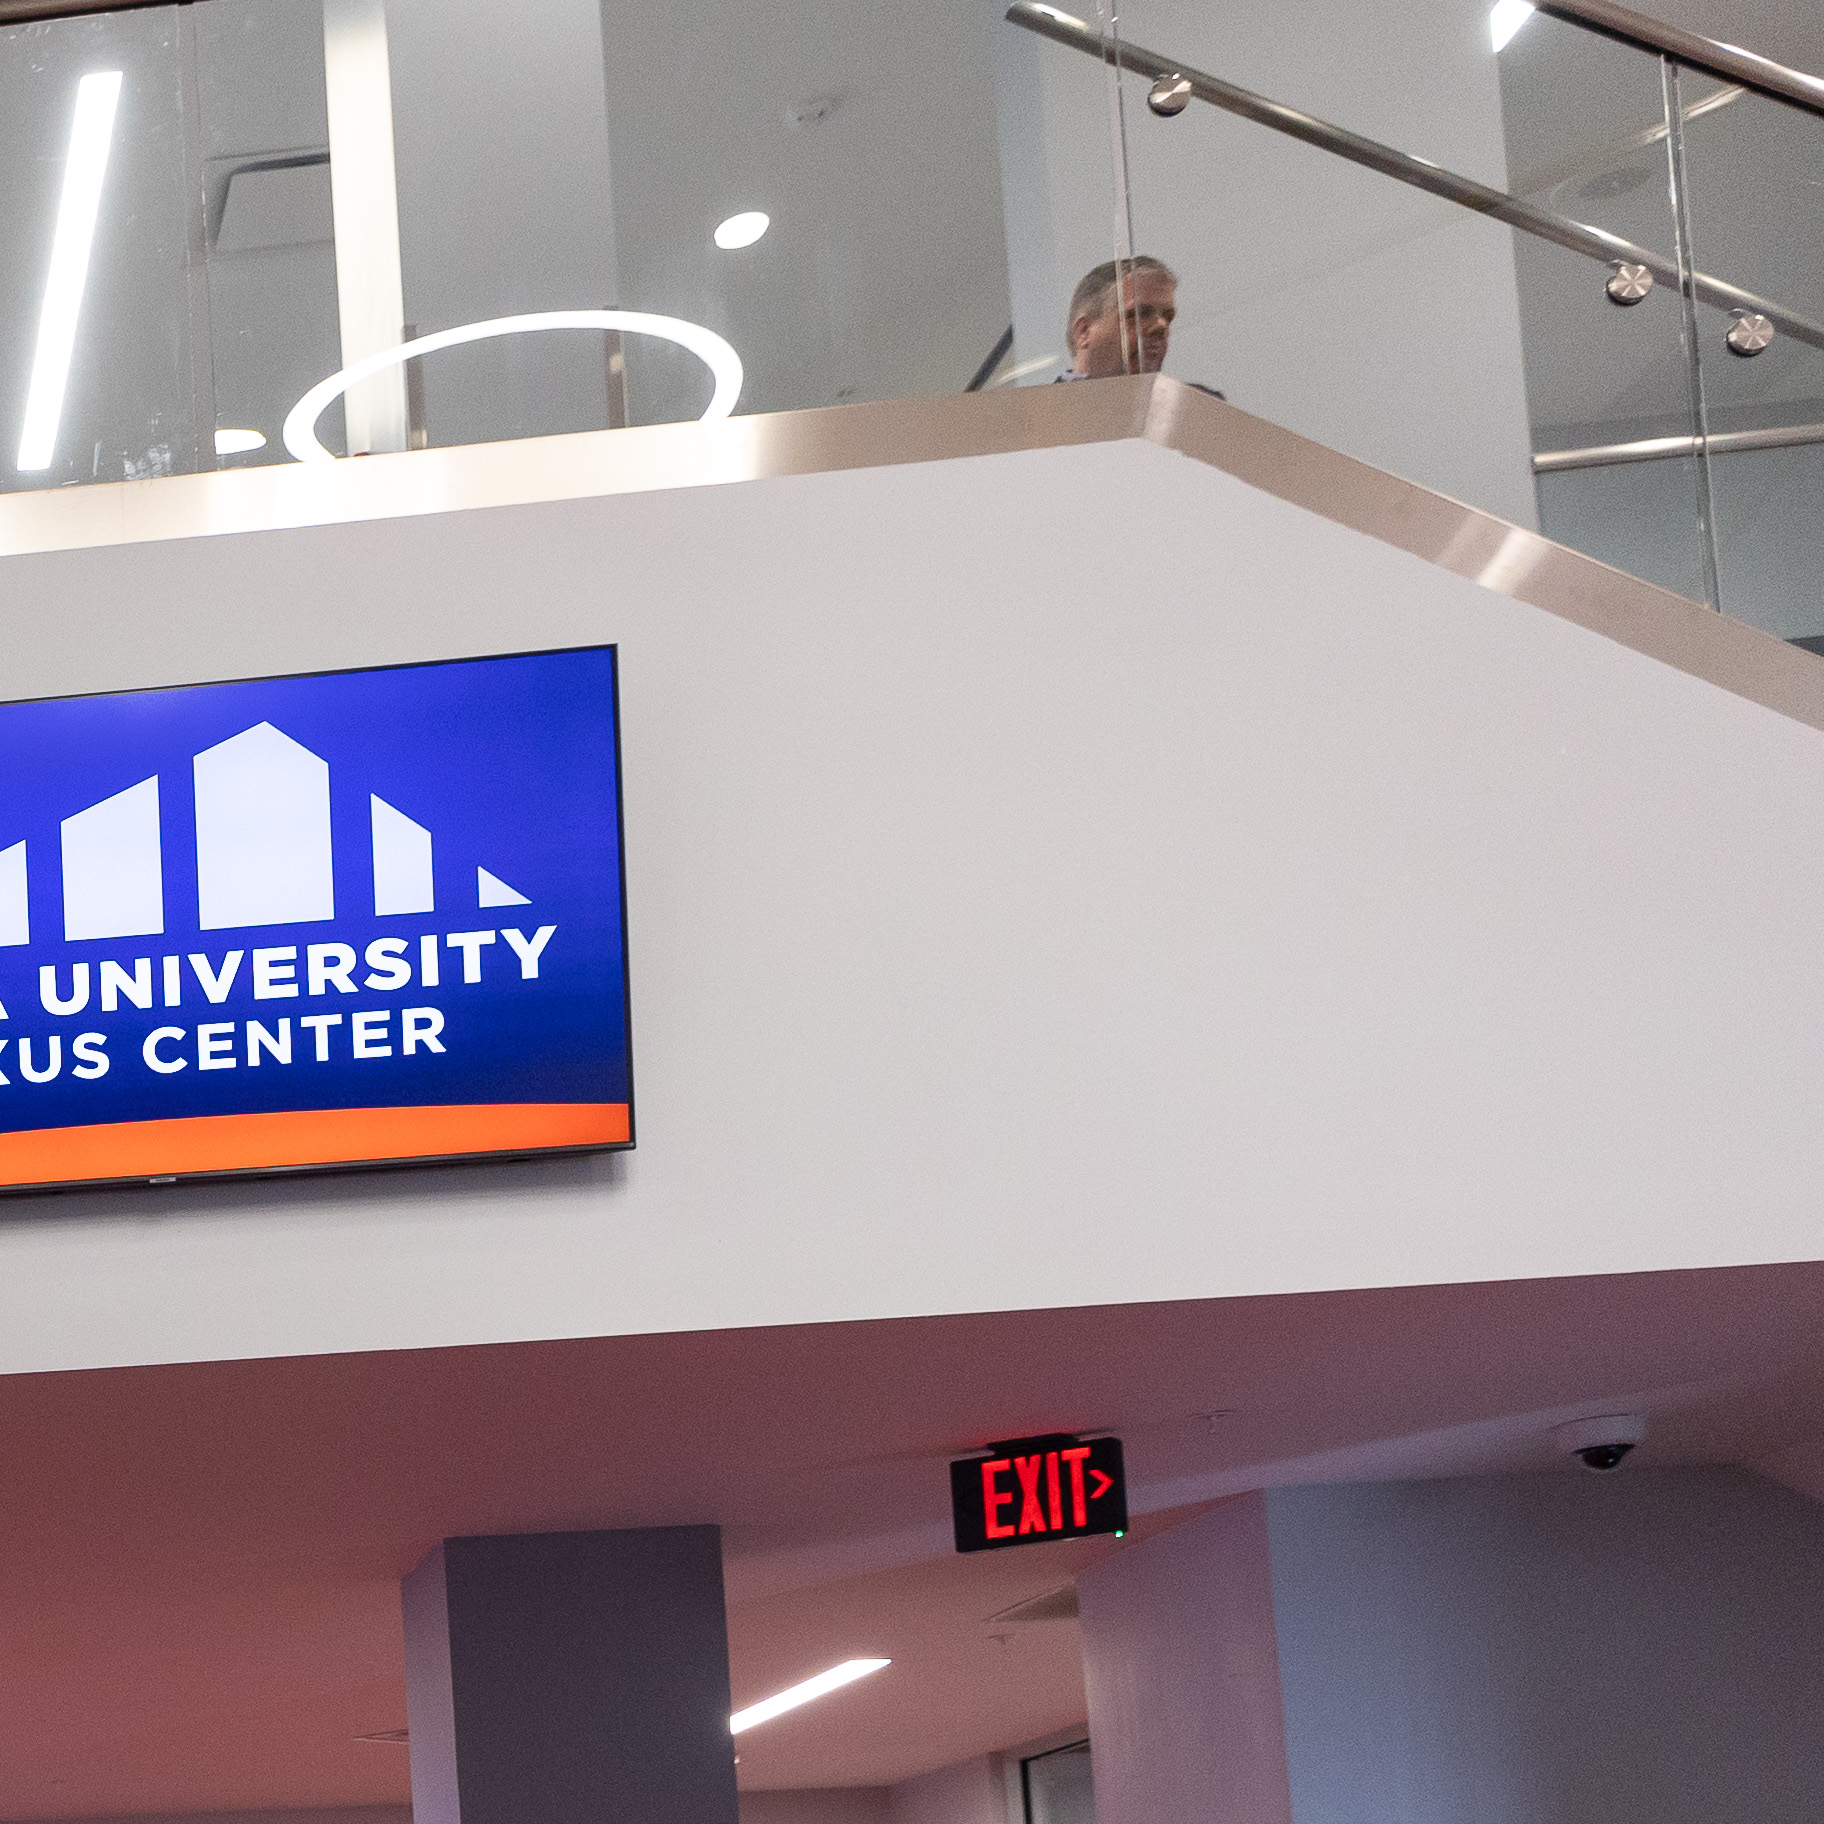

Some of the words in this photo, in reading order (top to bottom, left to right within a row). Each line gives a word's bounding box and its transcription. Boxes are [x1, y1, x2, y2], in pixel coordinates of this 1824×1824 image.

[38, 924, 558, 1018] UNIVERSITY
[141, 1006, 447, 1075] CENTER
[981, 1446, 1091, 1540] EXIT
